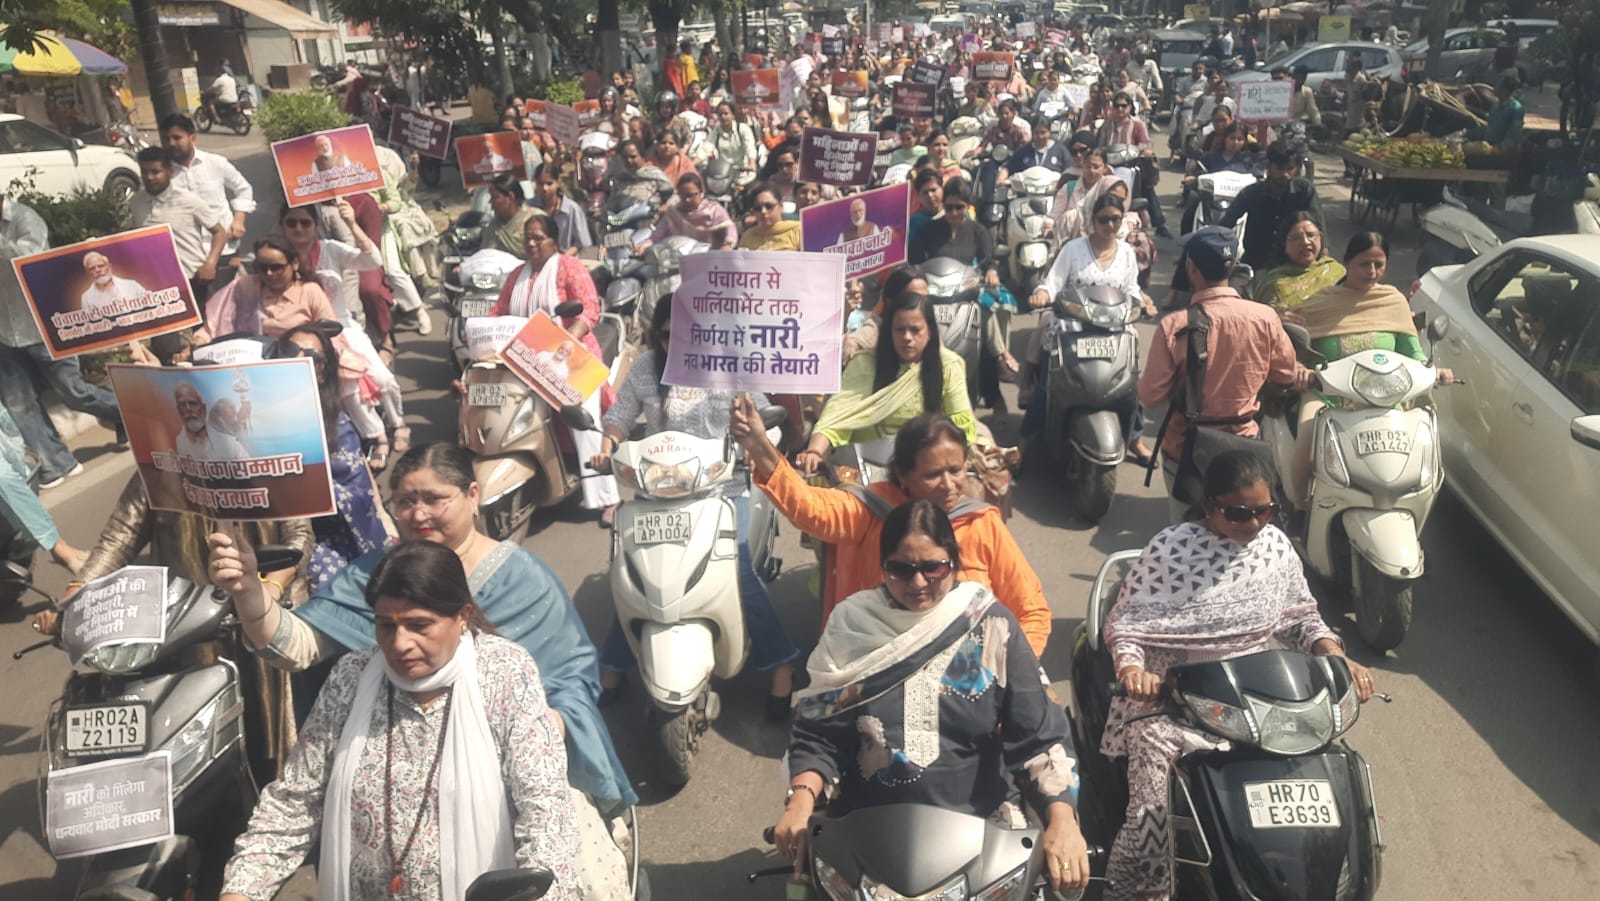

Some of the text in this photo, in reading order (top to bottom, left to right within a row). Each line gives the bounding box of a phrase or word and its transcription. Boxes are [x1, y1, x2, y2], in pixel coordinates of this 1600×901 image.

[708, 266, 781, 289] पंचायत से
[693, 291, 803, 319] पार्लियामेंट तक,
[690, 318, 804, 351] निर्णय में नारी,
[684, 351, 820, 375] नव भारत की तैयारी
[1365, 441, 1408, 452] AC1447
[1366, 431, 1401, 441] HR 02
[207, 457, 229, 479] का
[230, 453, 302, 479] सम्मान
[219, 487, 268, 508] उत्थान
[646, 514, 682, 527] HR 02
[641, 526, 689, 541] AP1004
[73, 577, 146, 612] महिलाओं की
[126, 605, 138, 619] में
[84, 707, 138, 728] HR02A
[82, 726, 137, 747] Z2119
[64, 780, 145, 807] नारी को मिलेगा
[1268, 783, 1320, 803] HR70
[83, 800, 126, 819] अधिकार,
[1268, 804, 1331, 825] E3639
[55, 807, 161, 840] धन्यवाद मोदी सरकार
